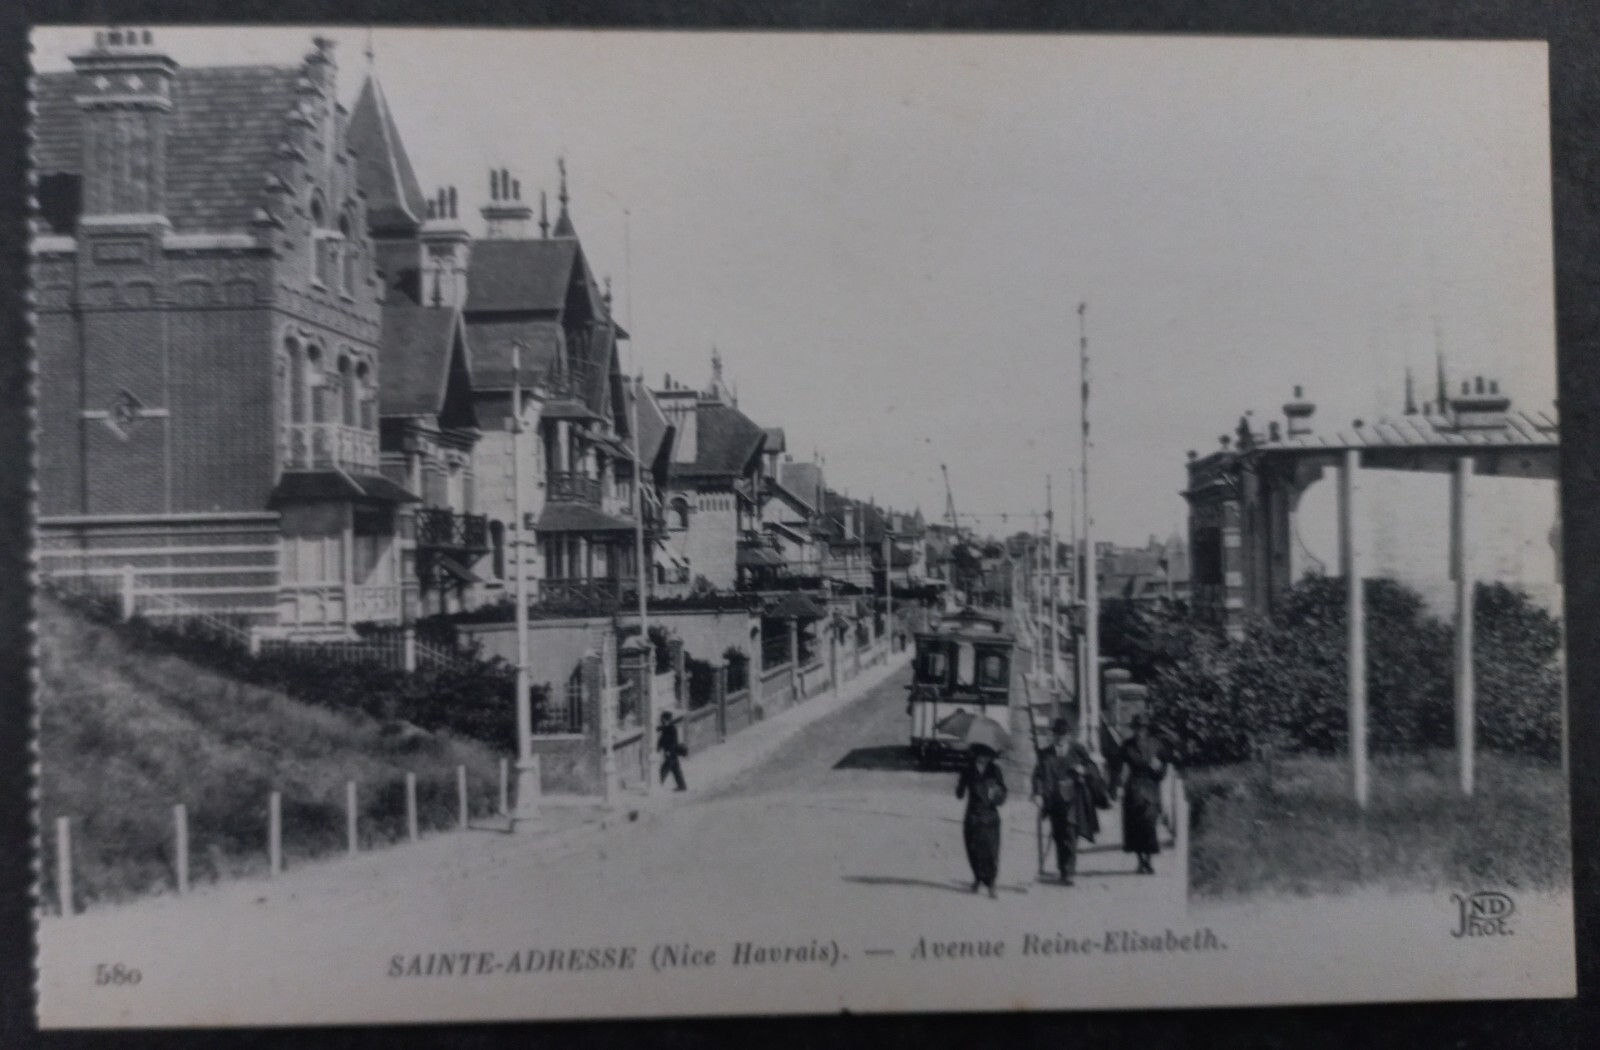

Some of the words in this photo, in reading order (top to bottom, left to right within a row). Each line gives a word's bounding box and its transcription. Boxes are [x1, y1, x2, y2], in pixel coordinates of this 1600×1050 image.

[387, 946, 638, 978] SAINTE-ADRESSE
[650, 944, 717, 973] (Nice
[731, 939, 849, 967] Havrais).
[910, 935, 1006, 960] Avenue
[1021, 927, 1229, 957] Reine-Elisabeth.
[95, 962, 143, 987] 580
